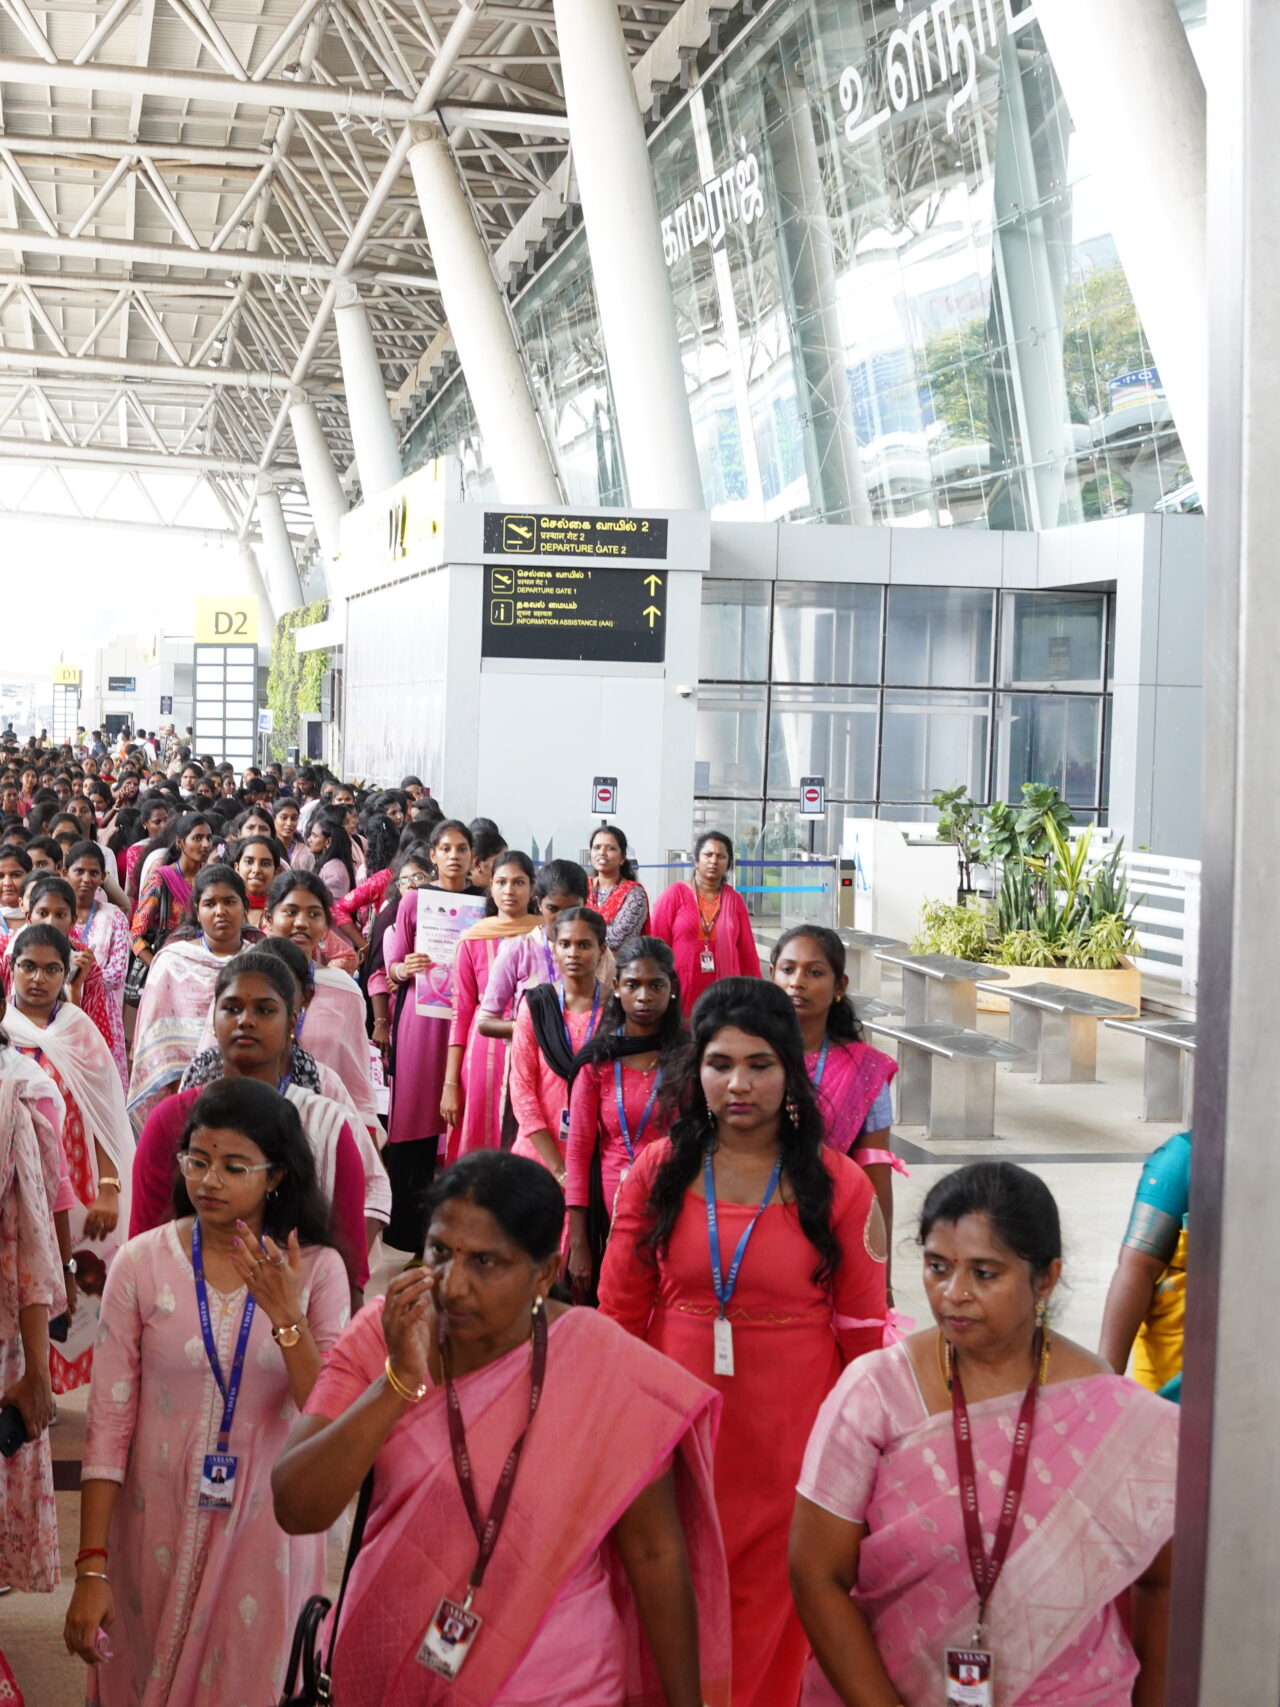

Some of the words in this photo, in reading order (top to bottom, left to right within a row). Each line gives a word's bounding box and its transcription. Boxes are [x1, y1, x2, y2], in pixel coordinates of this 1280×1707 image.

[661, 135, 764, 266] காமராஜ்
[579, 532, 585, 541] 2
[596, 519, 637, 532] வாயில்
[641, 521, 650, 532] 2
[540, 543, 594, 553] DEPARTURE
[595, 544, 619, 554] GATE
[620, 545, 627, 554] 2
[517, 586, 555, 594] DEPARTURE
[555, 587, 572, 595] GATE
[214, 611, 248, 635] D2
[598, 620, 614, 628] (AAI)
[62, 669, 77, 680] D1
[708, 1203, 716, 1226] VELS
[713, 1266, 721, 1290] VELS
[727, 1262, 739, 1285] VELS
[243, 1302, 254, 1328] VISTAS
[960, 1417, 968, 1440] VELS
[1015, 1422, 1027, 1445] VELS
[967, 1485, 976, 1511] VELS
[1003, 1490, 1016, 1515] VELS
